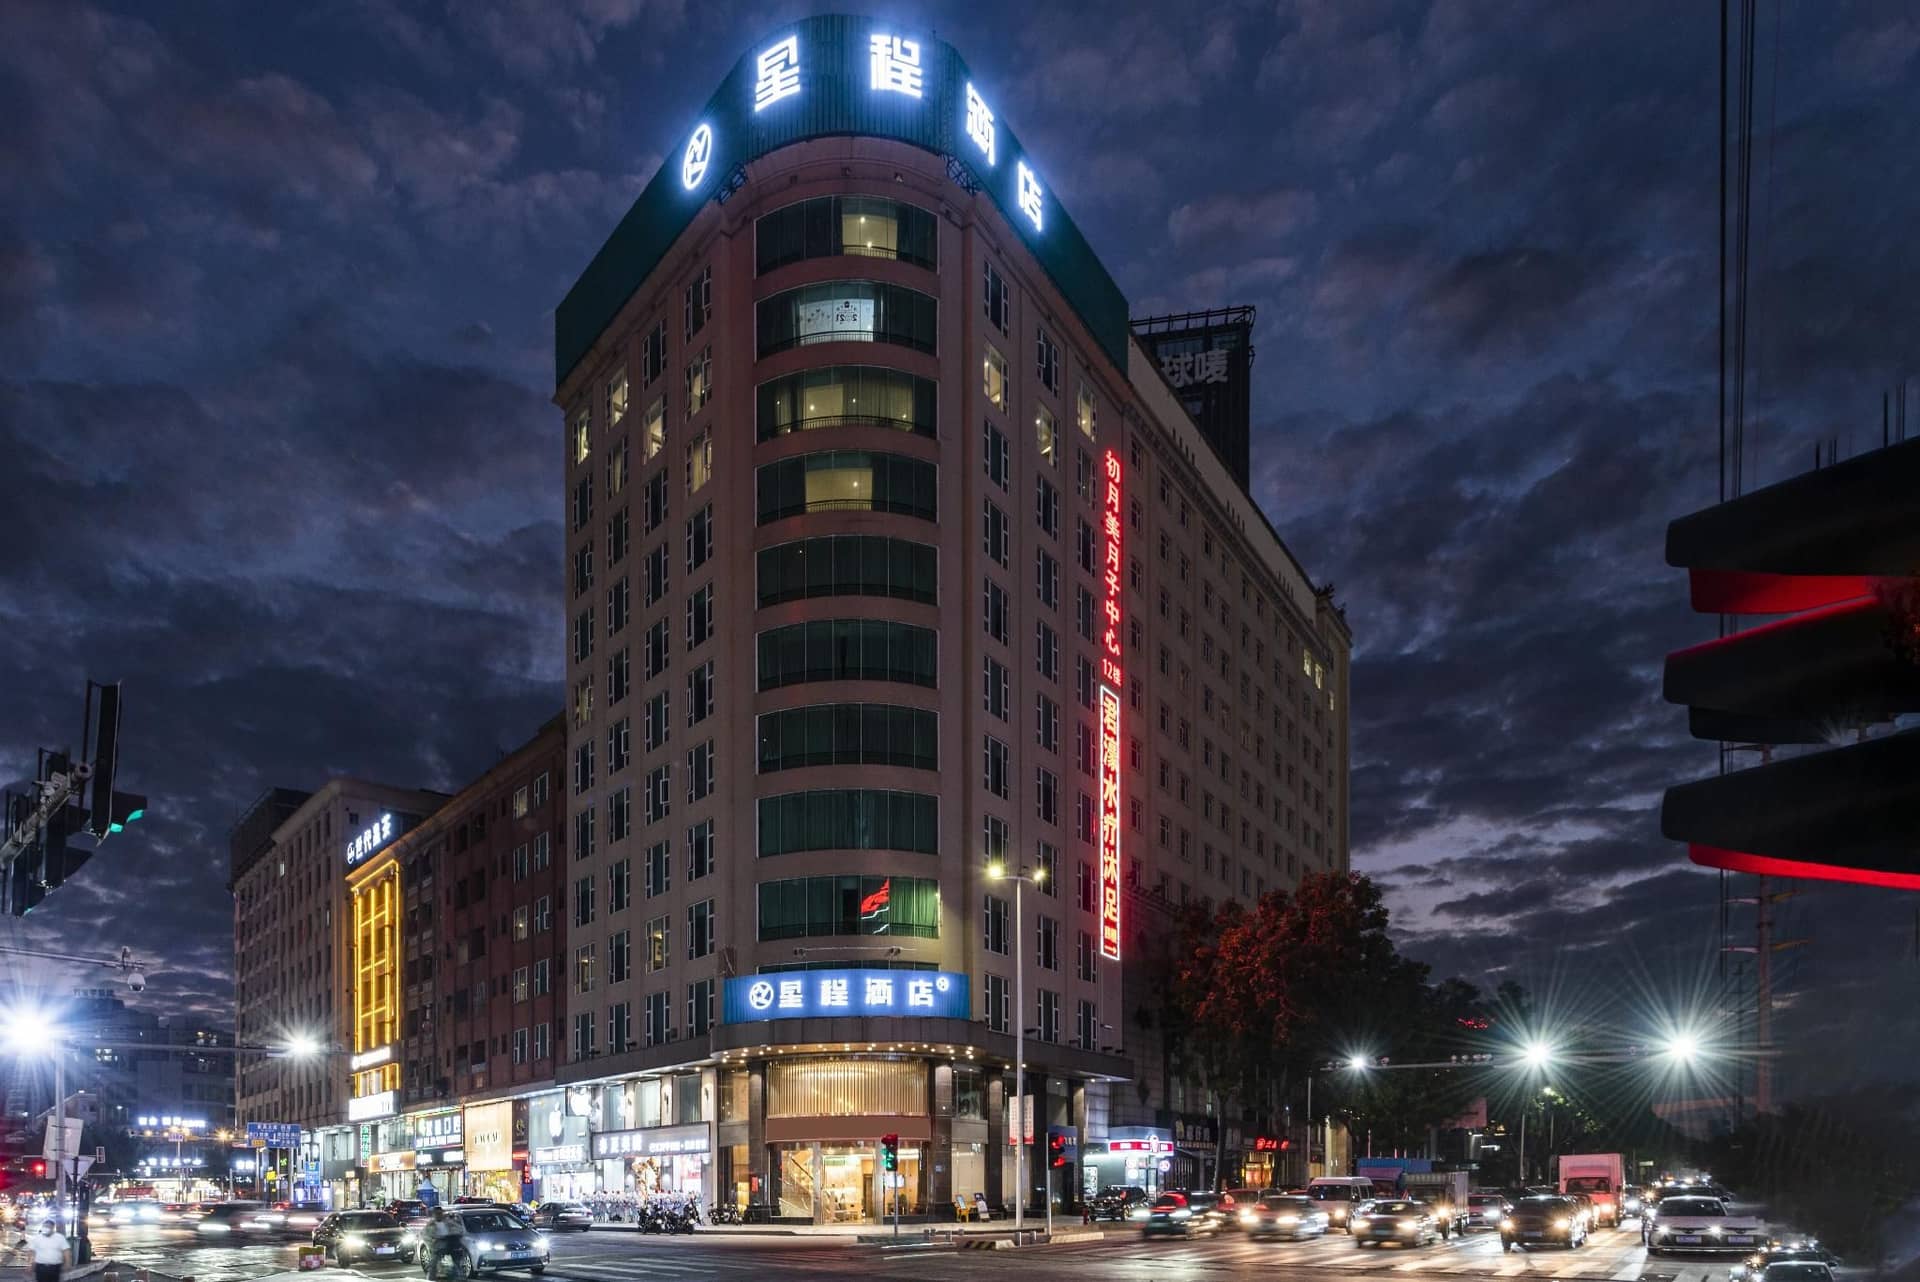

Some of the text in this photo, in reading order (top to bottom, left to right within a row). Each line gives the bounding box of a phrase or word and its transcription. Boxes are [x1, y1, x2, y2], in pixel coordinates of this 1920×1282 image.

[754, 33, 1043, 232] 星程酒店
[1105, 450, 1121, 657] 初月美月子中心
[778, 976, 934, 1008] 星程酒店
